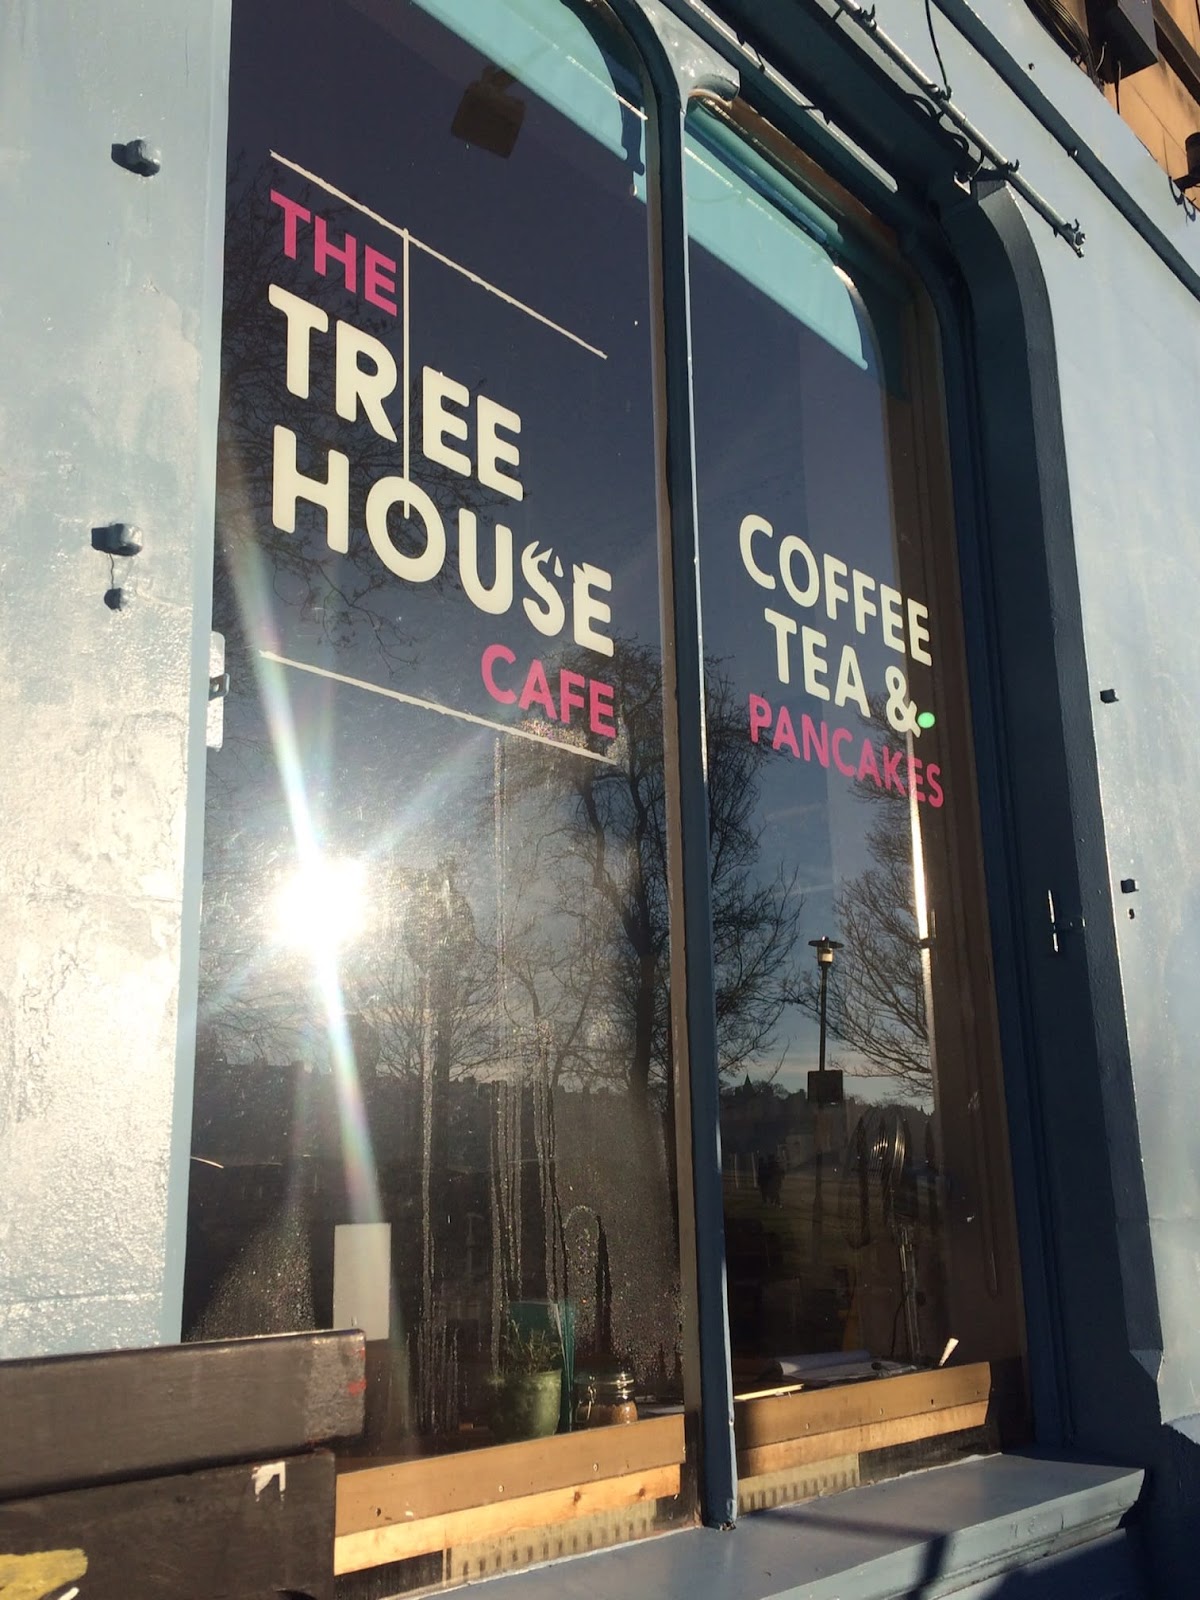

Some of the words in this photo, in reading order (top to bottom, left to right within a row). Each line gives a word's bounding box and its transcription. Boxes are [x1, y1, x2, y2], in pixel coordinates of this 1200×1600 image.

[270, 189, 397, 316] THE
[268, 283, 523, 502] TREE
[272, 424, 614, 657] HOUSE
[739, 514, 932, 667] COFFEE
[481, 644, 616, 738] CAFE
[764, 608, 871, 718] TEA
[885, 665, 921, 738] &
[749, 693, 944, 808] PANCAKES
